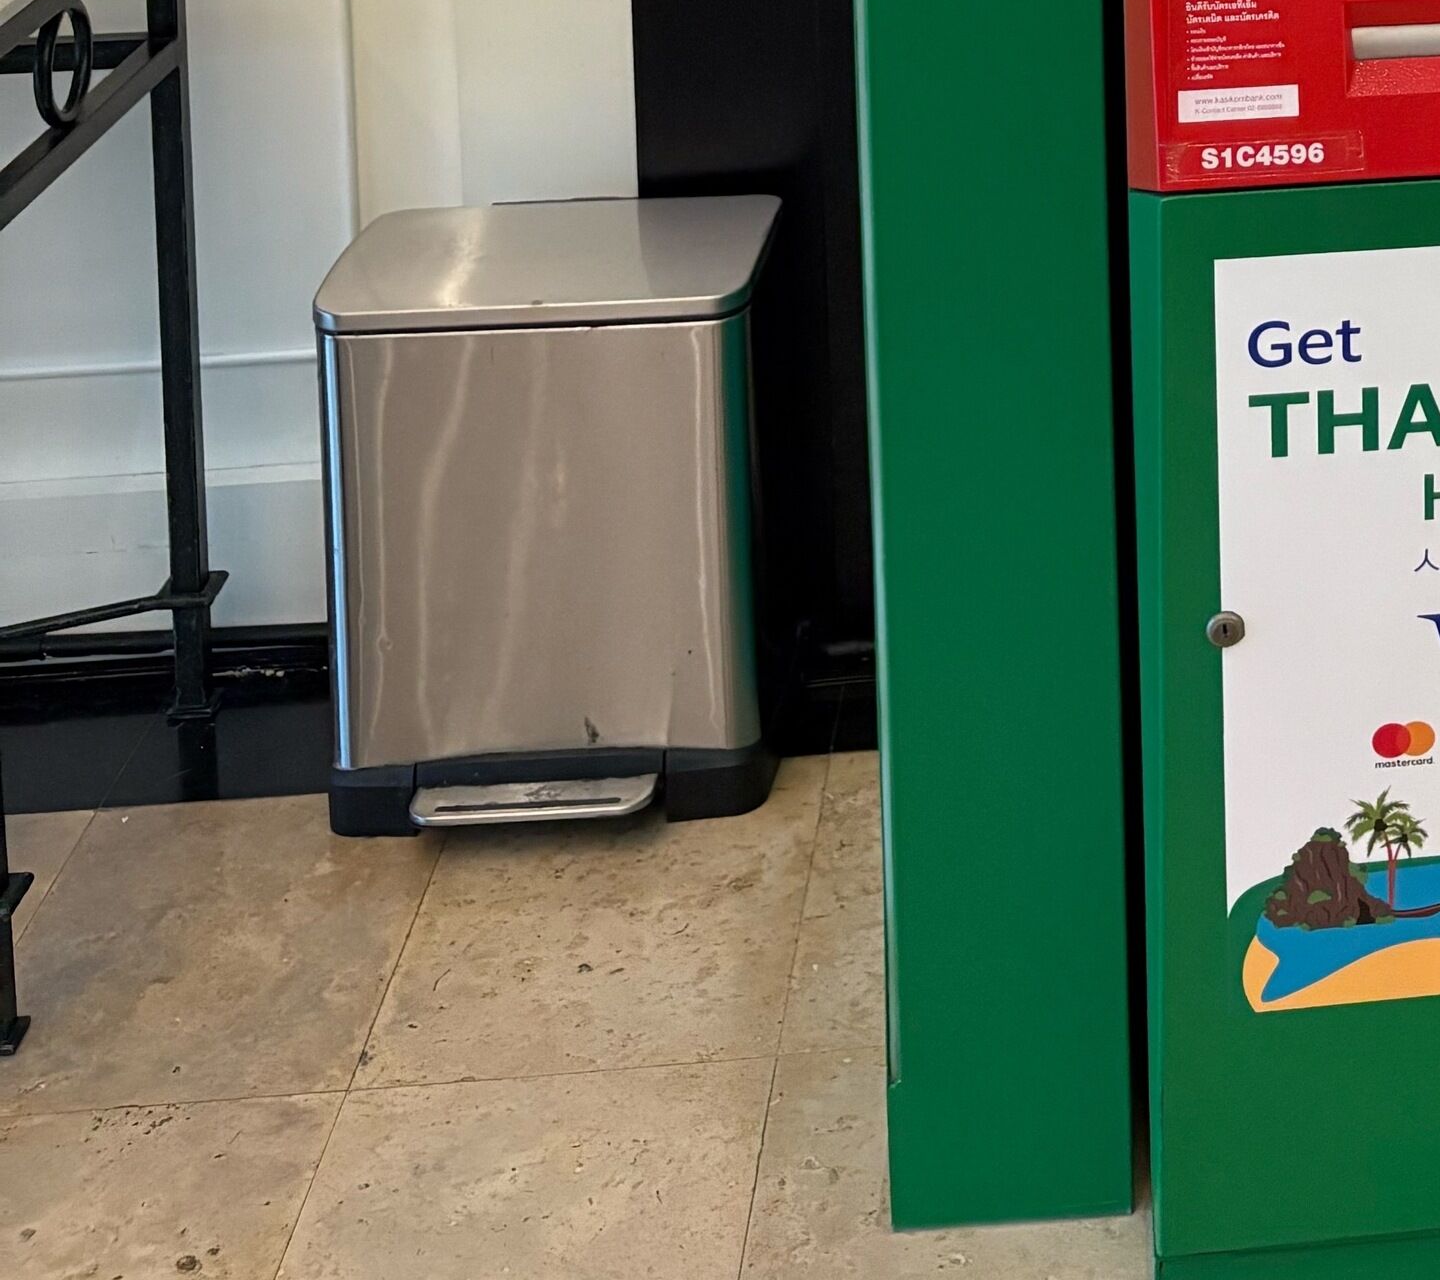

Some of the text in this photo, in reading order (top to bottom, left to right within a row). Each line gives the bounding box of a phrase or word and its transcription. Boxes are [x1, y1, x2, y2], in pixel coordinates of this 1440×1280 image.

[1201, 142, 1325, 169] S1C4596
[1247, 319, 1363, 369] Get
[1374, 755, 1434, 769] mastercard
